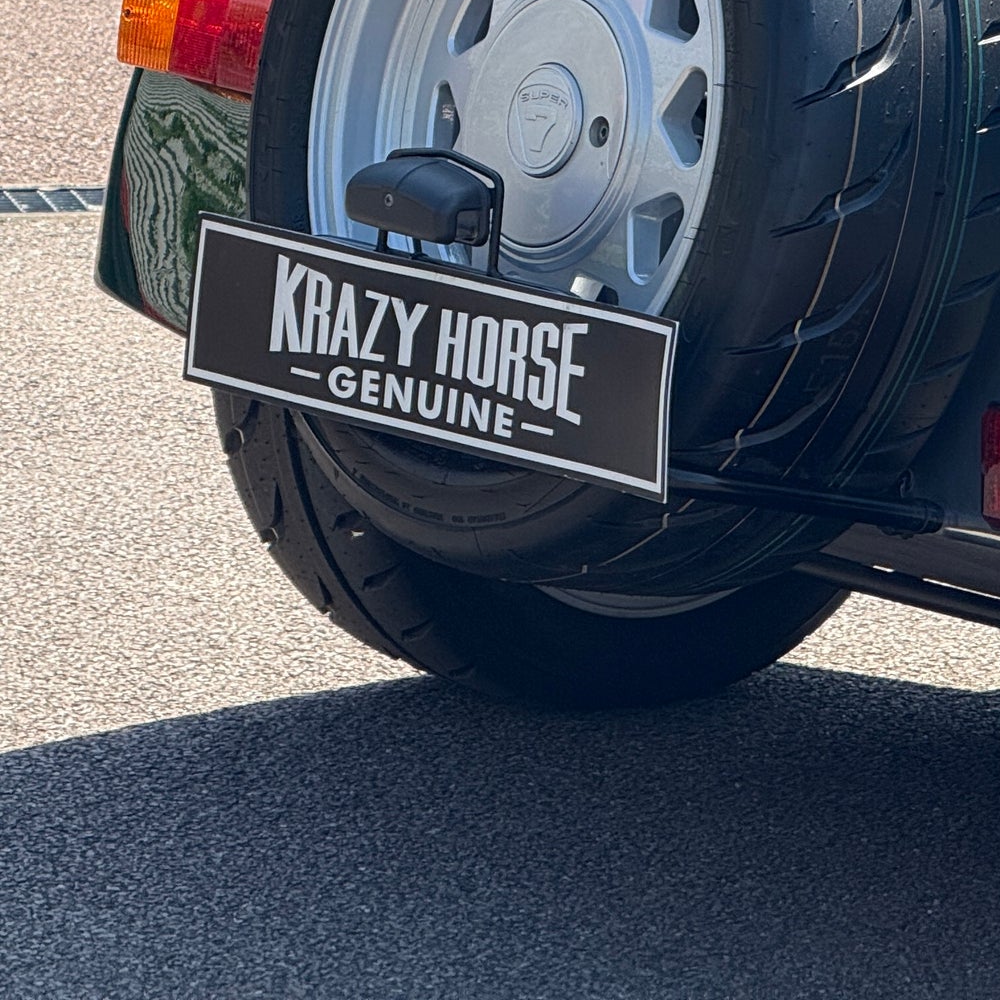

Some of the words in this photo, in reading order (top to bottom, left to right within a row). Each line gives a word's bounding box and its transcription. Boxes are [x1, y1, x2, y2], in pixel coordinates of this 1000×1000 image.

[520, 90, 568, 109] SUPER
[525, 104, 557, 152] 7
[269, 254, 429, 367] KRAZY
[436, 308, 589, 426] HORSE
[327, 365, 514, 439] GENUINE
